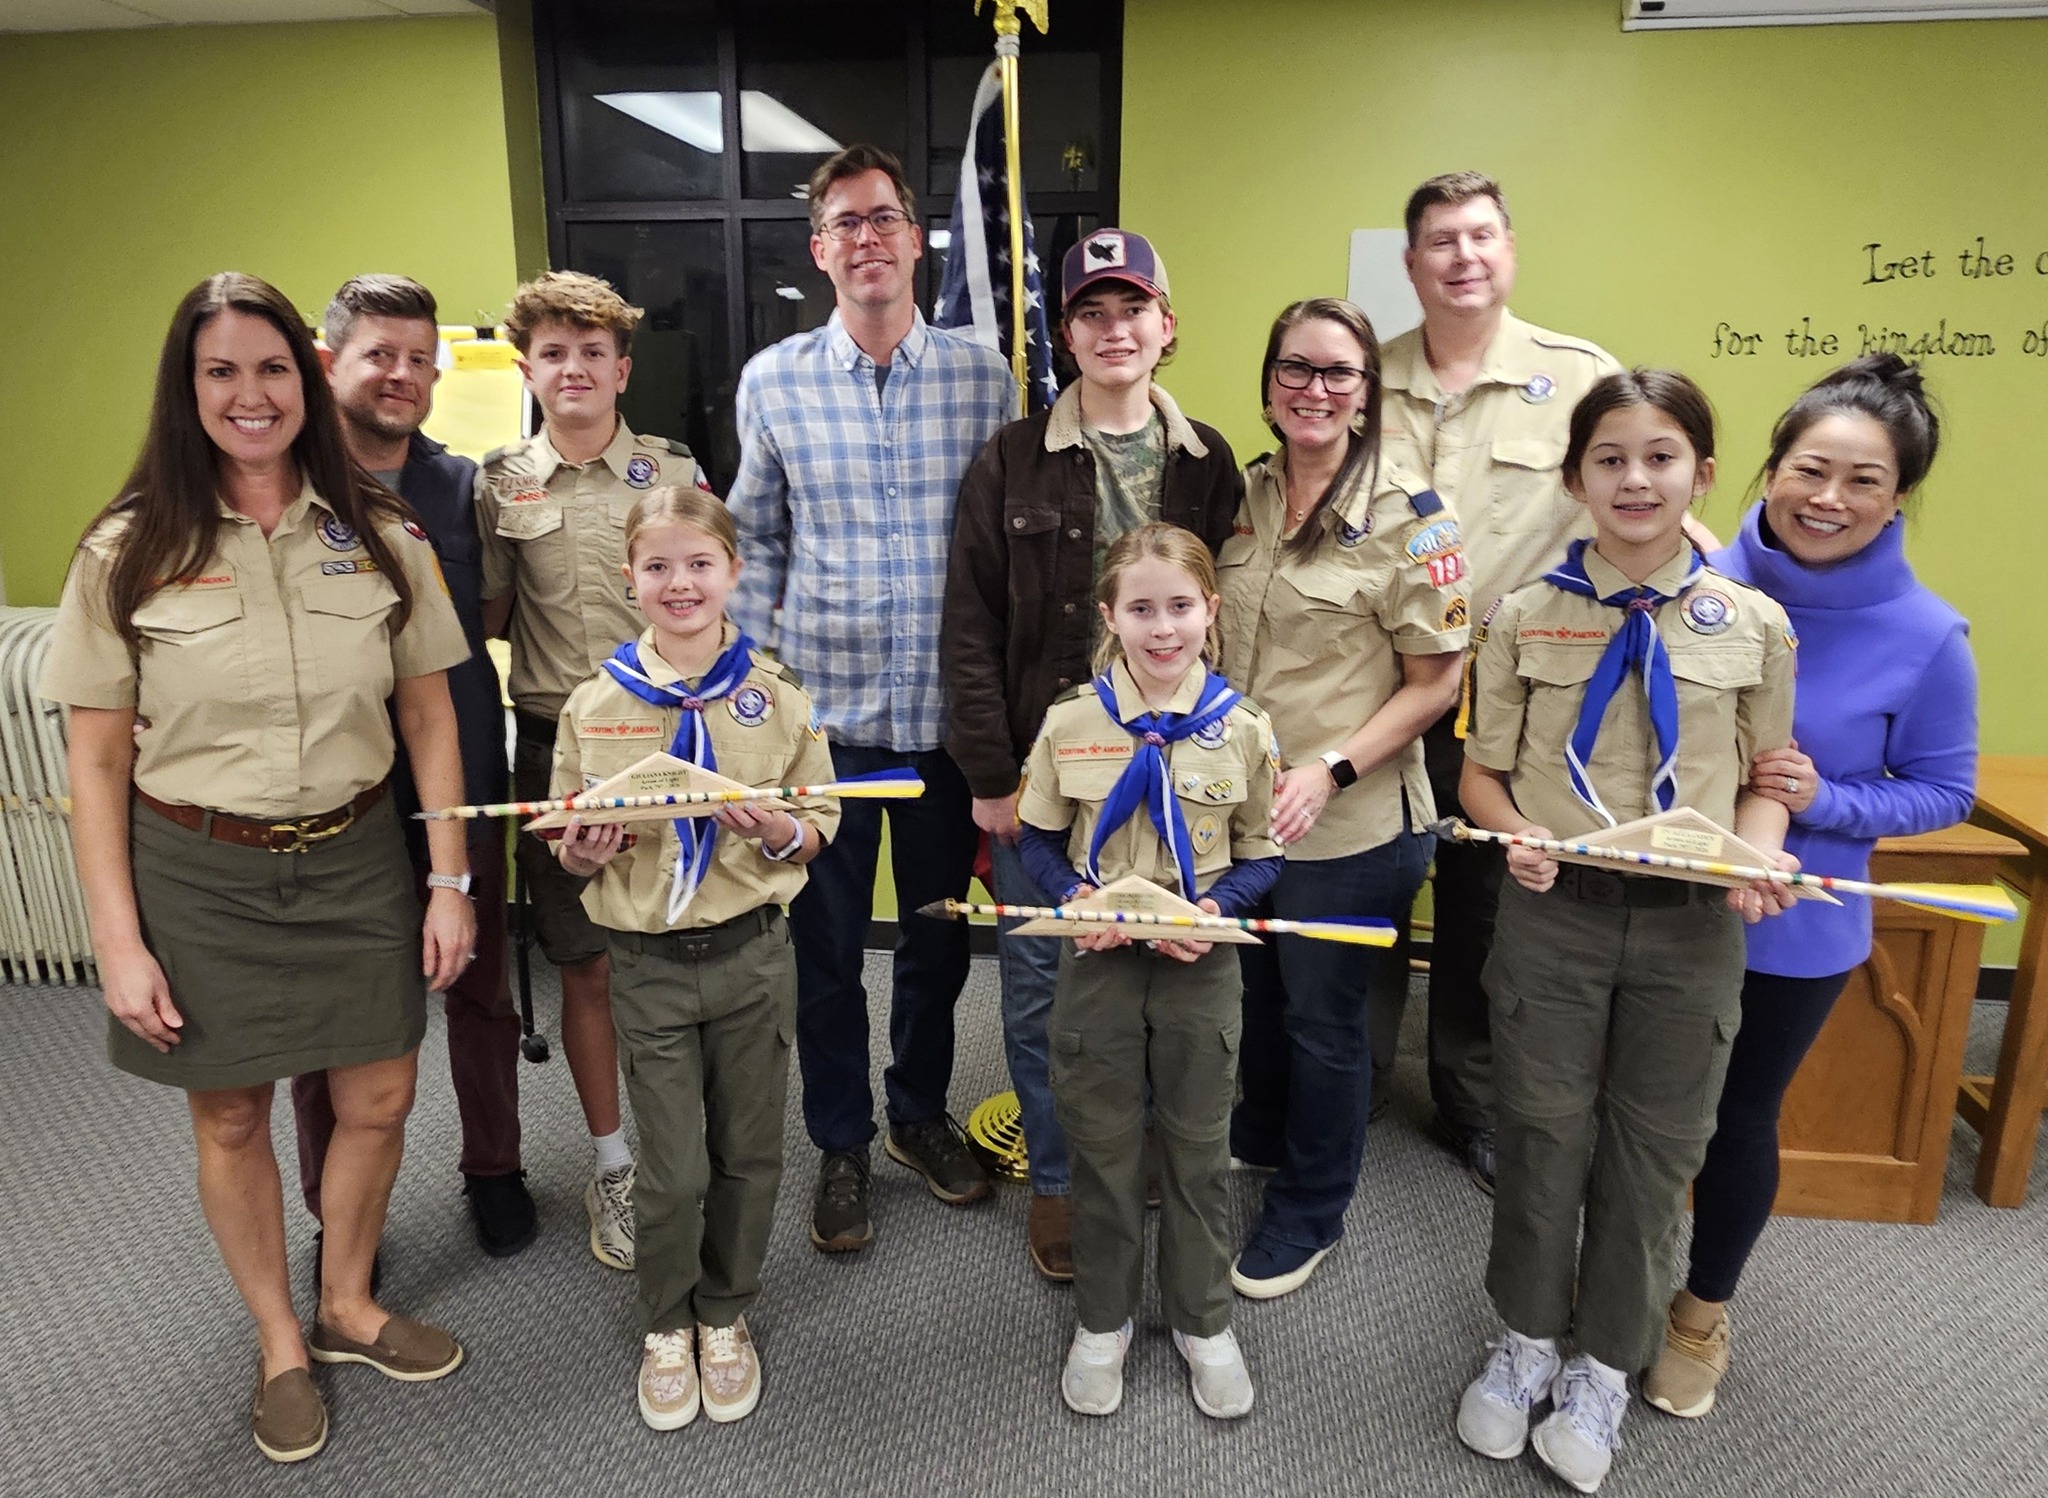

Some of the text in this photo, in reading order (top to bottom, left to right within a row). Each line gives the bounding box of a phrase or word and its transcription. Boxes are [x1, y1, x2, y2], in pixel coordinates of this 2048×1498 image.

[1862, 242, 1936, 285] Let
[1957, 236, 2014, 279] the
[1711, 316, 2048, 361] for the kingdom of
[1571, 630, 1605, 639] AMERICA
[631, 725, 660, 734] AMERICA
